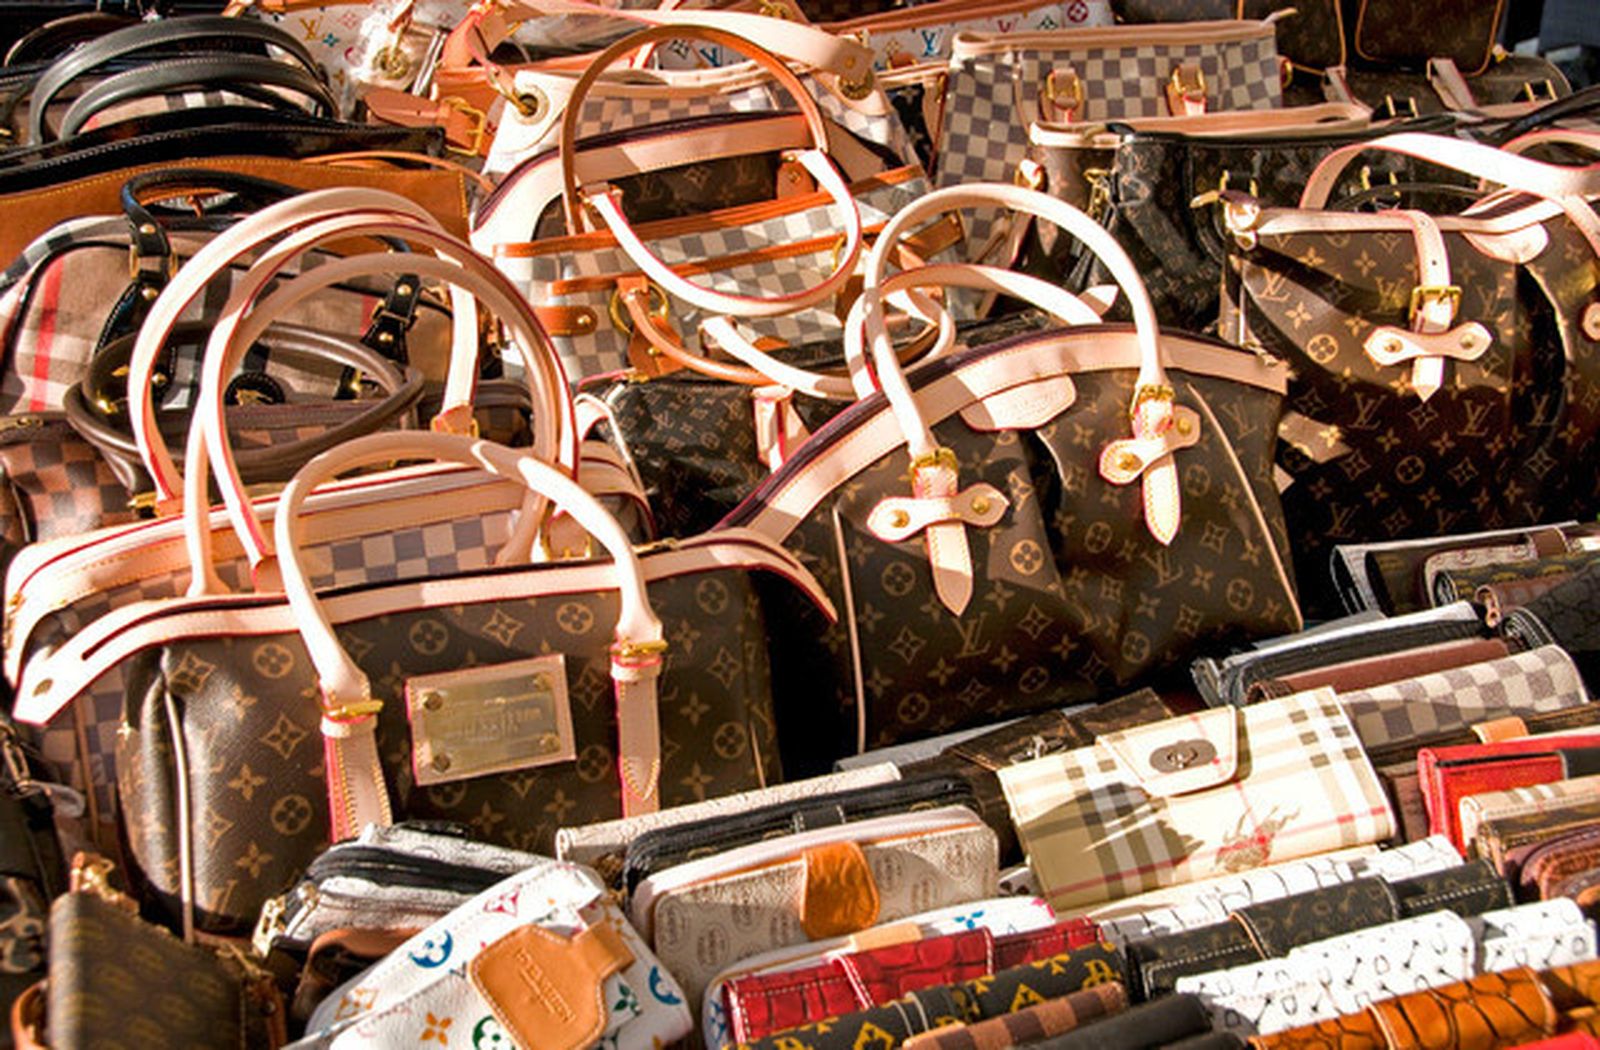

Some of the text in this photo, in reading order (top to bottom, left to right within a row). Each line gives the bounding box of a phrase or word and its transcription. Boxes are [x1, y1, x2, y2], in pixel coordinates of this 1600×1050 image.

[1257, 266, 1291, 302] LV
[1347, 391, 1388, 430] LV
[1456, 399, 1497, 437] LV
[1323, 501, 1361, 538] LV
[953, 611, 992, 659] LV
